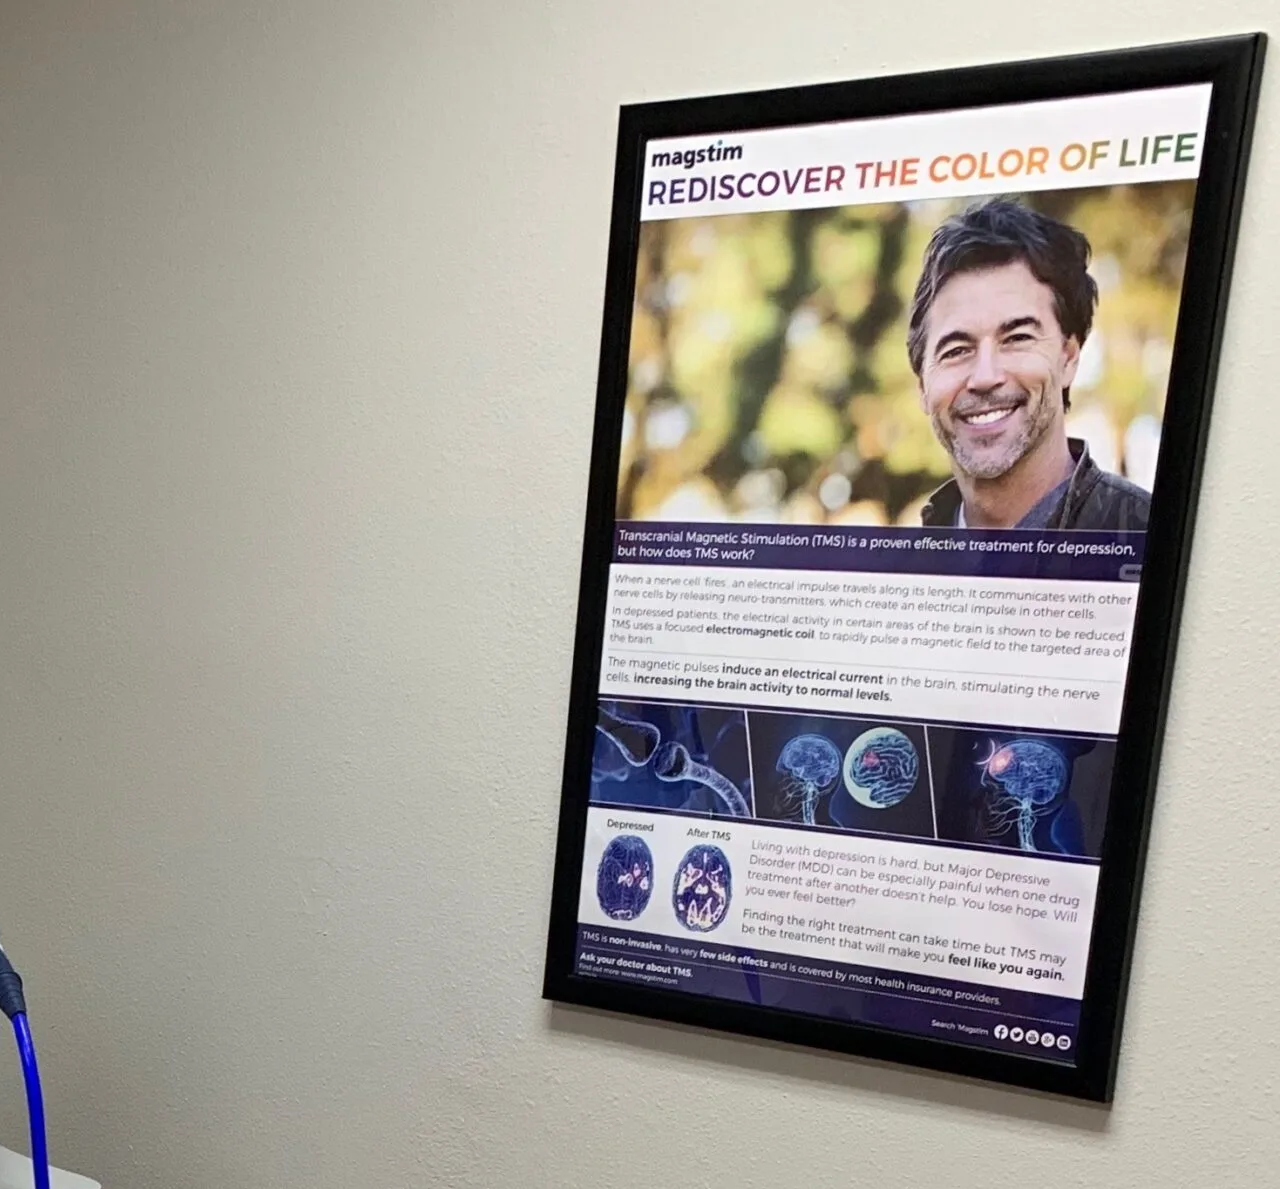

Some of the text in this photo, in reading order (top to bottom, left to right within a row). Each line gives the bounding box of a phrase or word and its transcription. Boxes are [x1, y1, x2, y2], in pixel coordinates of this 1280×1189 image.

[647, 132, 1198, 206] REDISCOVER THE COLOR OF LIFE
[651, 139, 743, 169] magstim
[616, 544, 755, 560] but how does TMS work?
[618, 529, 1136, 557] Transcranial Magnetic Stimulation (TMS) is a proven effective treatment for depression,
[613, 588, 1066, 618] nerve cells releasing which create electrical impulse other
[614, 573, 1133, 605] When nerve cell electrical impulse travels along communicates with other
[622, 606, 1036, 637] depressed electrical activity certain areas brain shown
[611, 618, 1110, 657] TMS uses focused electromagnetic rapidly pulse magnetic field targeted area
[607, 655, 1100, 700] The magnetic pulses induce an electrical current stimulating nerve
[633, 671, 892, 702] increasing the brain activity to normal levels.
[606, 817, 654, 832] Depressed
[685, 827, 731, 841] After TMS
[751, 839, 1051, 887] Living with depression but Major Depressive
[744, 885, 765, 896] you
[766, 888, 791, 899] ever
[792, 889, 814, 902] feel
[746, 869, 803, 886] treatment
[804, 876, 832, 889] after
[832, 881, 880, 896] another
[961, 896, 985, 910] You
[987, 899, 1013, 914] lose
[1053, 908, 1078, 923] Will
[748, 853, 1080, 910] Disorder (MDD) especially painful when one drug
[741, 922, 1065, 981] be the treatment that will make you feel like you again.
[742, 907, 1067, 968] Finding the right treatment can take time but TMS may
[579, 951, 693, 977] Ask your doctor about TMS.
[582, 930, 600, 942] TMS
[664, 943, 679, 954] has
[679, 947, 698, 959] very
[698, 948, 717, 959] few
[716, 951, 737, 963] side
[736, 954, 768, 968] effects
[769, 961, 788, 971] and
[797, 965, 833, 978] covered
[847, 973, 873, 984] most
[873, 975, 905, 989] health
[906, 981, 953, 997] insurance
